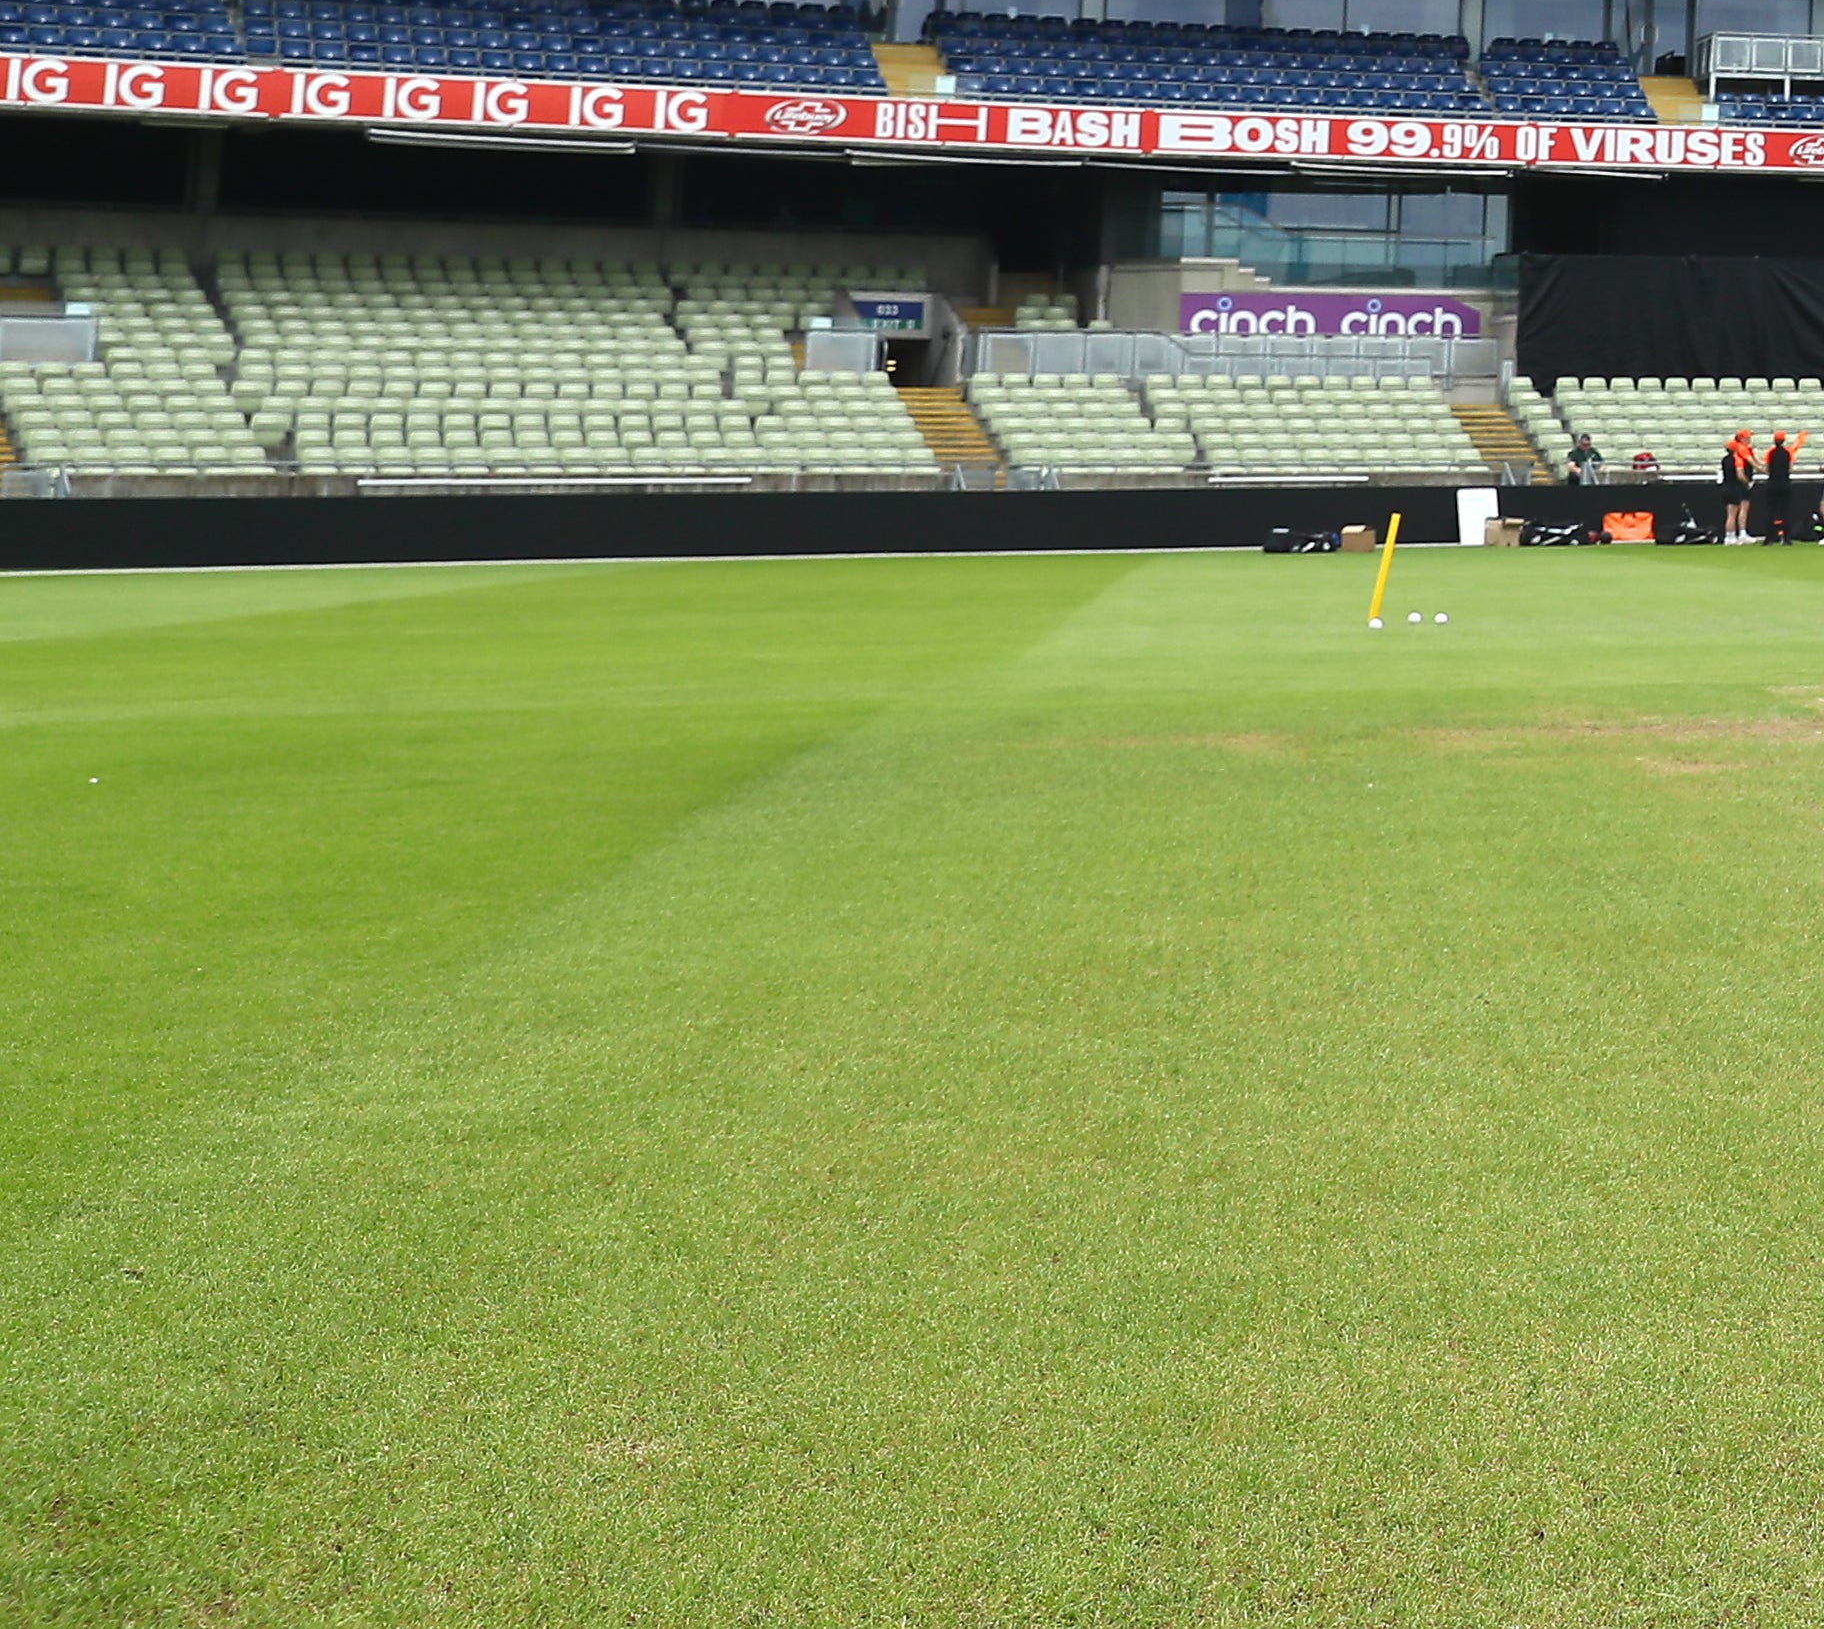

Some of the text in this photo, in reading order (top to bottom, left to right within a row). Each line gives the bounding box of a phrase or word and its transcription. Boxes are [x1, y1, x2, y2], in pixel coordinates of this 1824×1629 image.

[10, 60, 69, 102] IG
[103, 64, 165, 106] IG
[199, 68, 258, 110] IG
[290, 71, 351, 117] IG
[383, 77, 441, 120] IG
[471, 80, 529, 123] IG
[570, 87, 624, 129] IG
[654, 90, 709, 131] IG
[874, 103, 1766, 166] BISH BASH BOSH 99.9% OF VIRUSES
[1190, 296, 1316, 333] cinch
[1341, 298, 1462, 334] cinch
